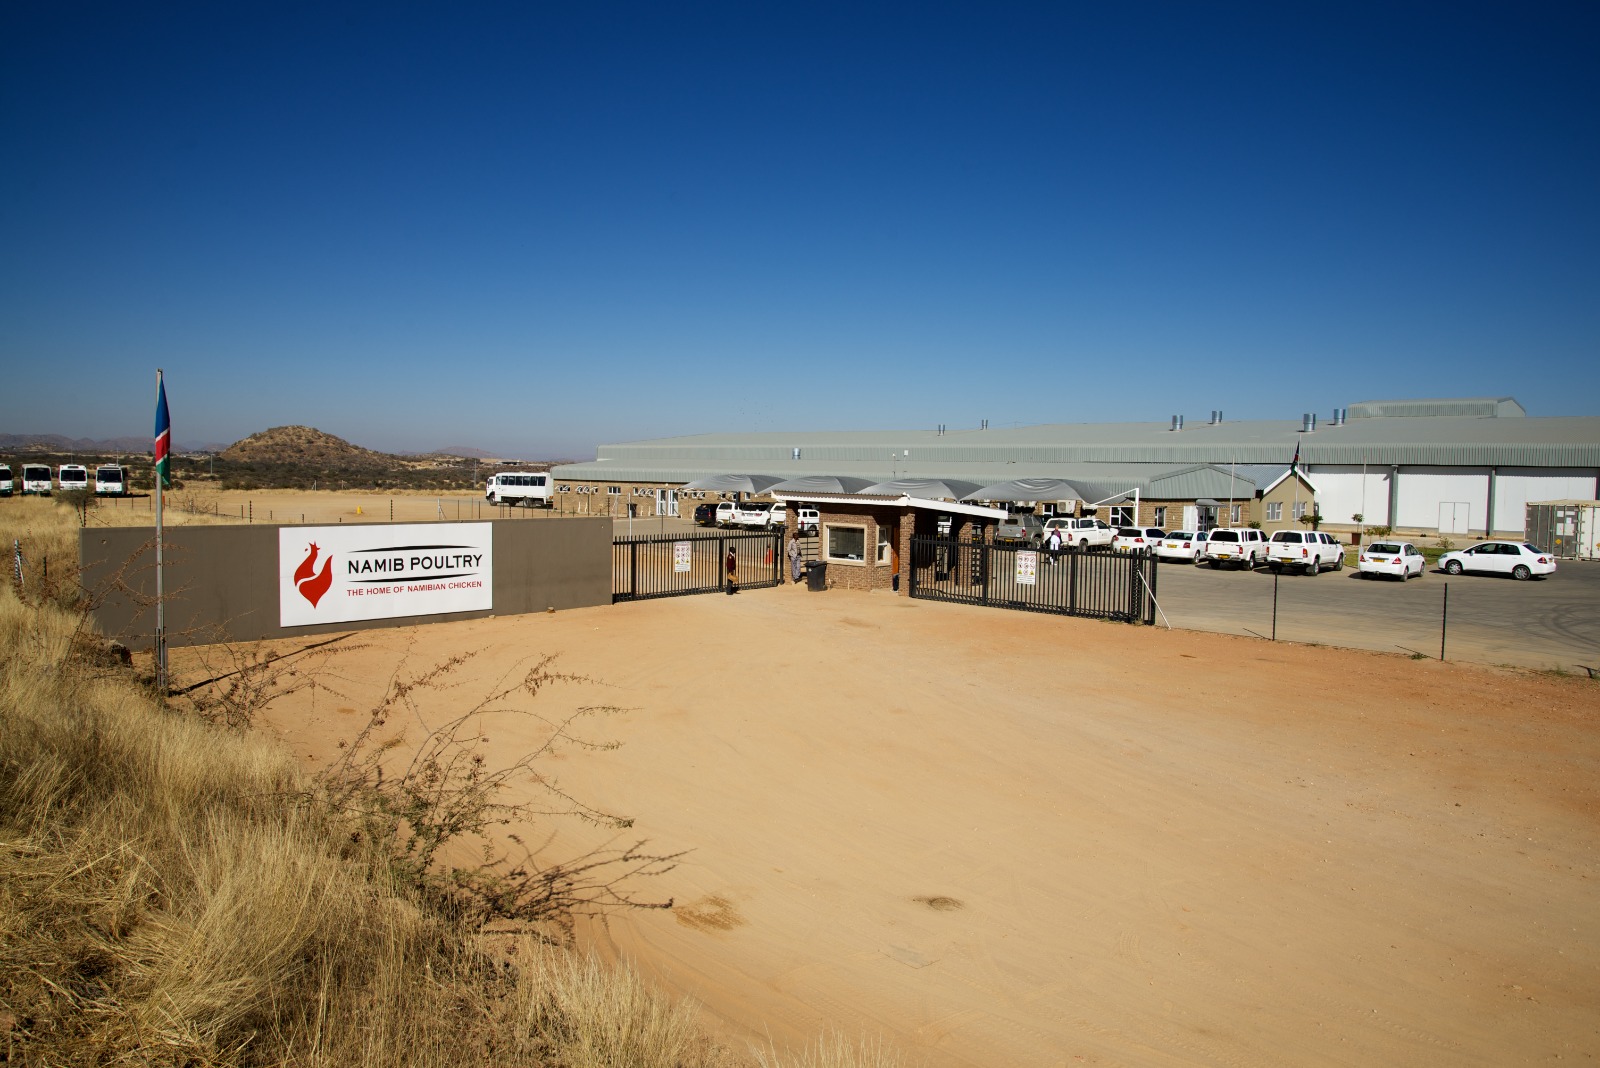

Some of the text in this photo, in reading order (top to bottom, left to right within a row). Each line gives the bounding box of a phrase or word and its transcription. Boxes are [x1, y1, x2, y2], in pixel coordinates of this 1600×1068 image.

[348, 554, 483, 574] NAMIB POULTRY
[347, 589, 364, 597] THE
[366, 587, 391, 595] HOME
[407, 583, 446, 592] NAMIBIAN
[448, 581, 482, 589] CHICKEN
